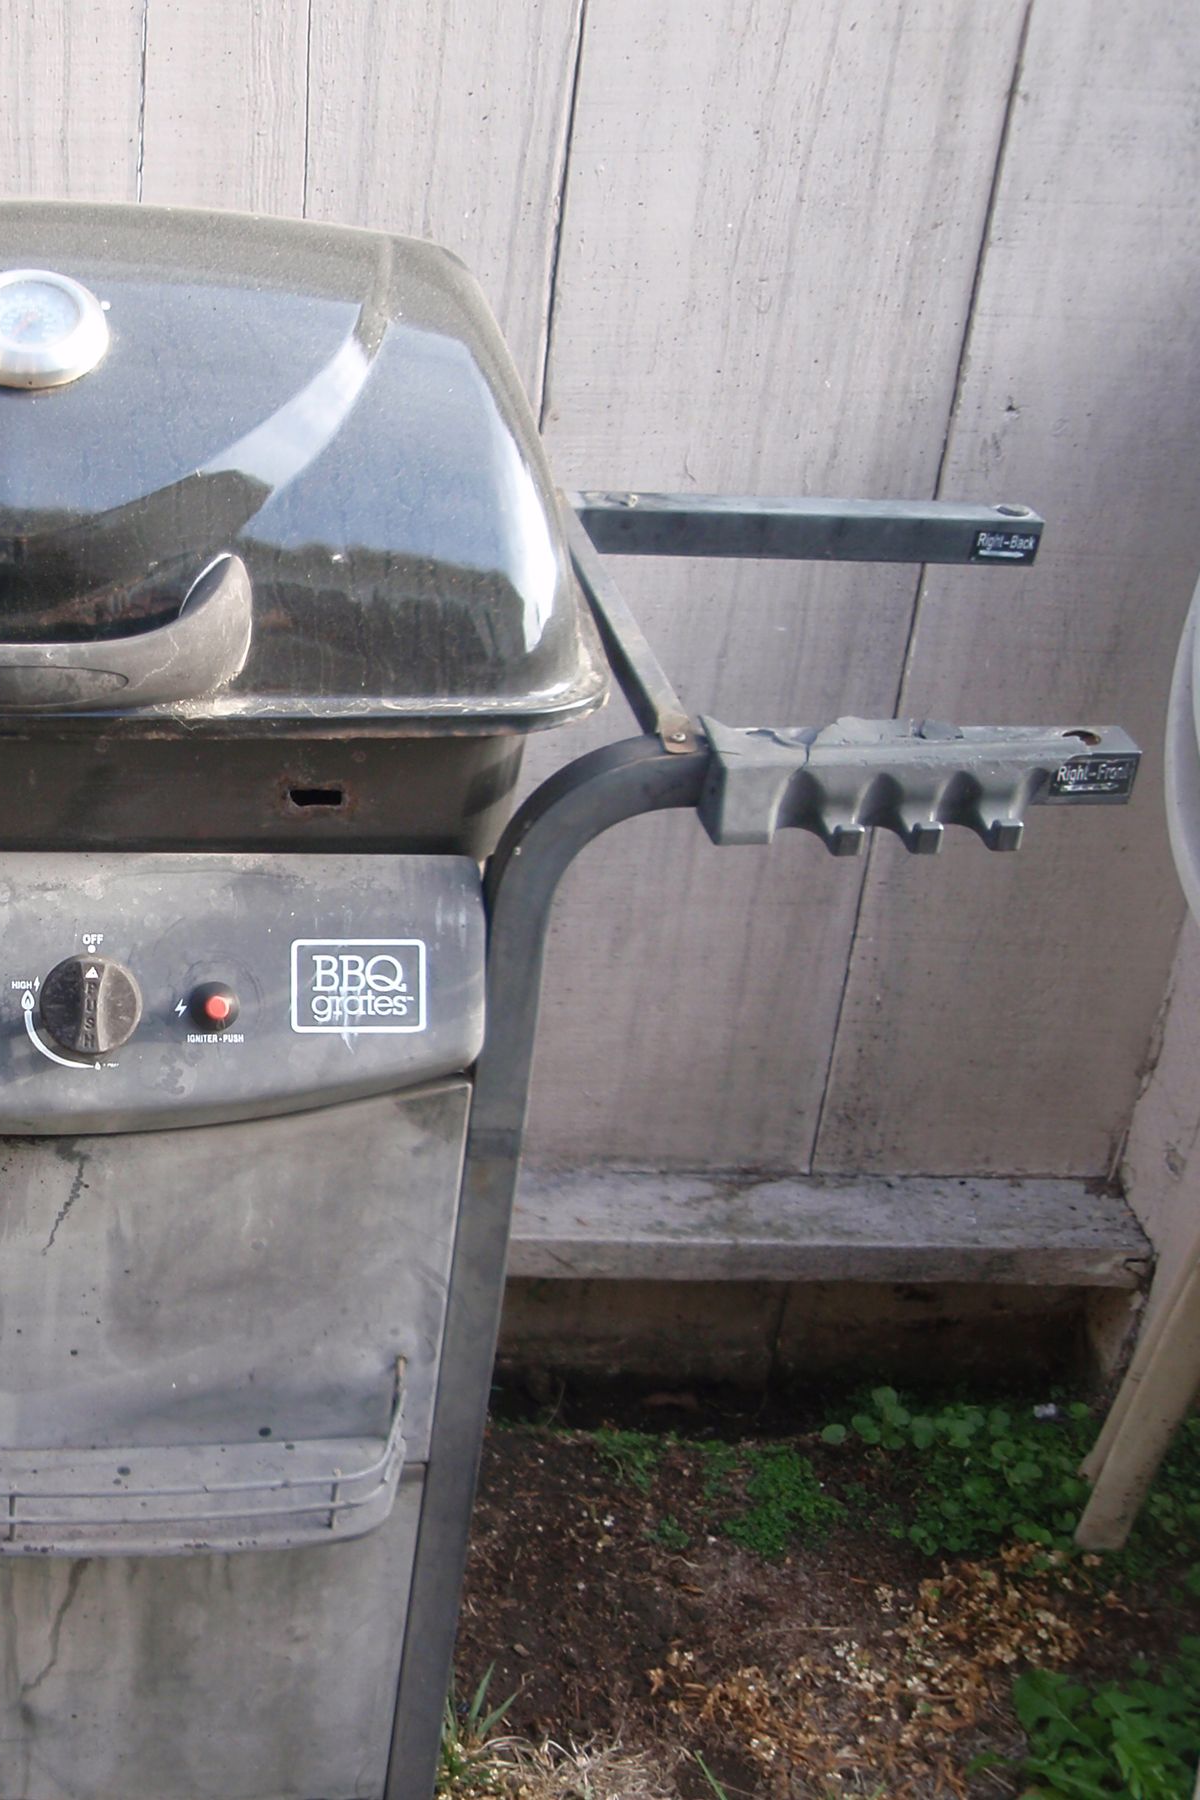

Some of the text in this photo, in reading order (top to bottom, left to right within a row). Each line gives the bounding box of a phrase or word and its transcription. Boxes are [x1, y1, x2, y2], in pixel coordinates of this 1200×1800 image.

[976, 532, 1036, 551] Right-Back
[82, 934, 104, 945] OFF
[311, 955, 407, 992] BBQ
[11, 980, 33, 989] HIGH
[311, 990, 408, 1022] grates
